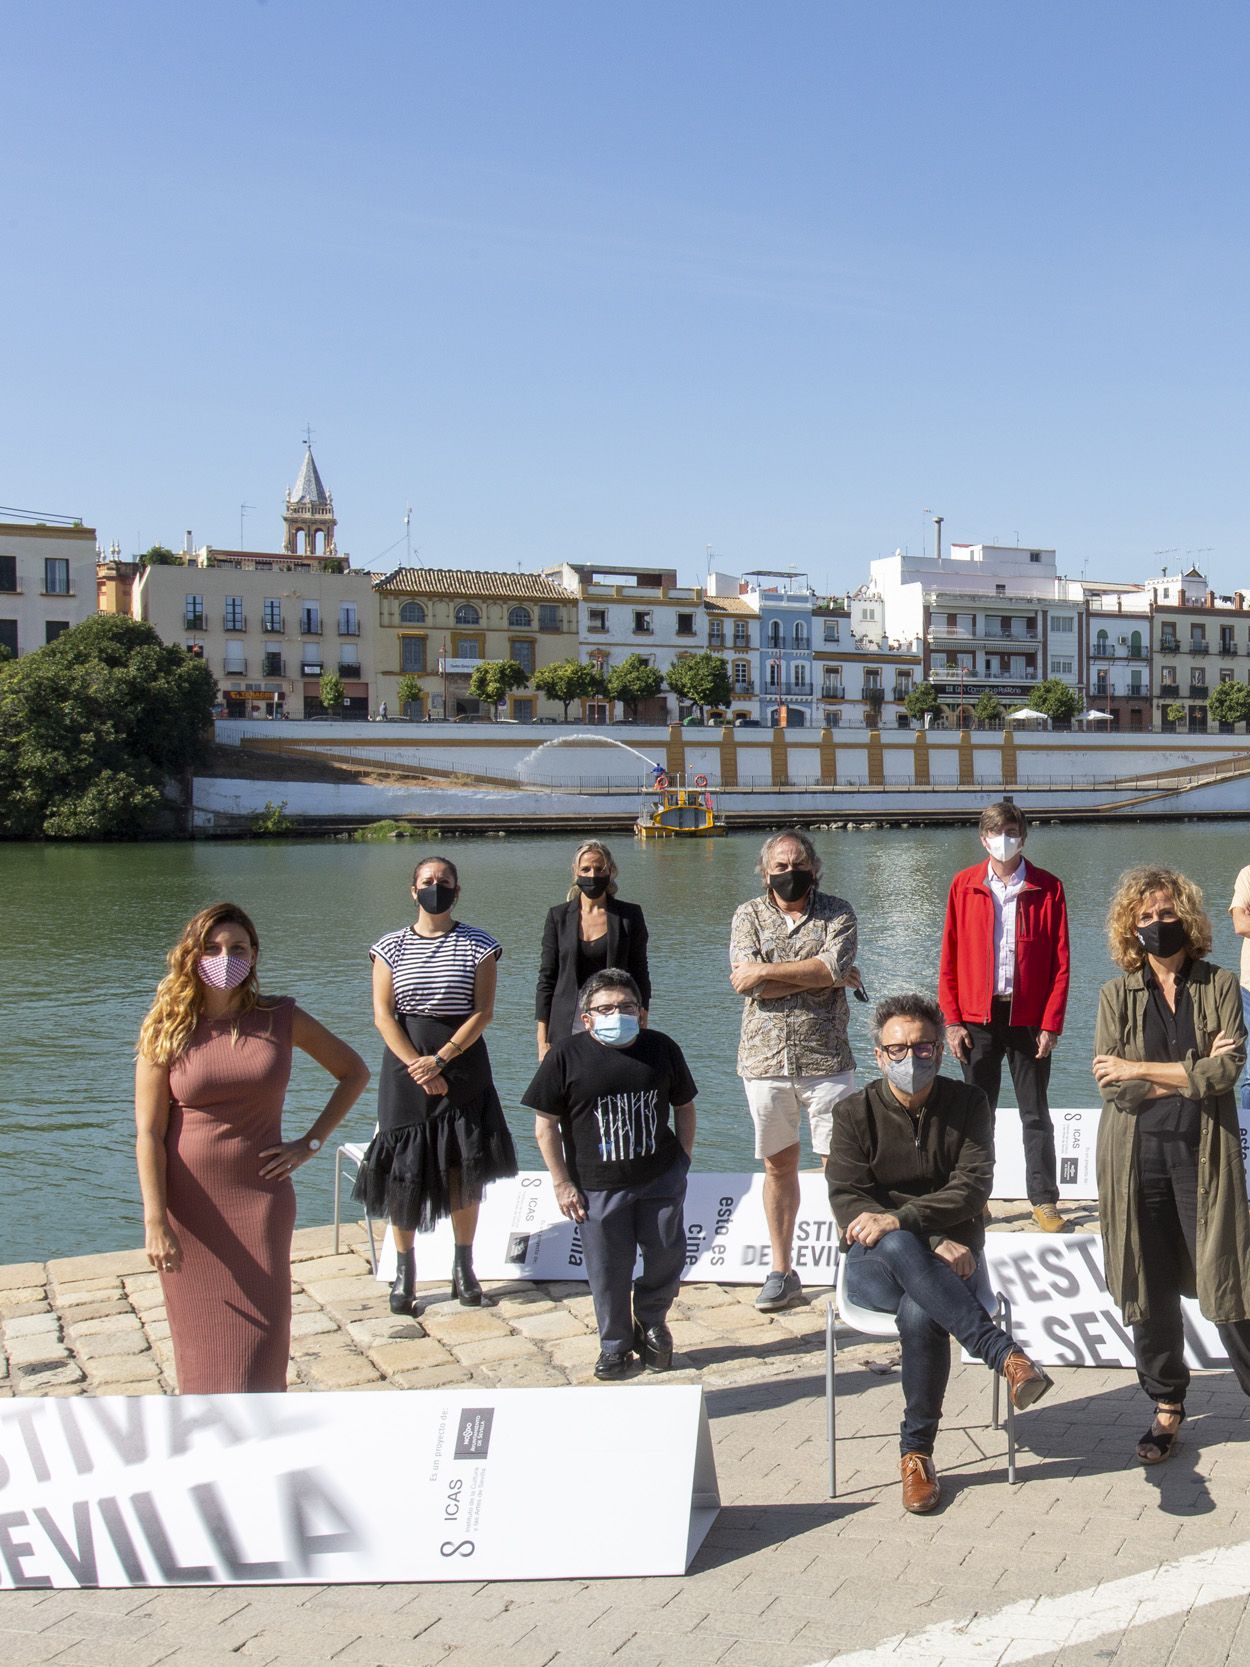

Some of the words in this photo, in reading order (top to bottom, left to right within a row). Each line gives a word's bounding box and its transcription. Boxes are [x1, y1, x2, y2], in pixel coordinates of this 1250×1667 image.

[525, 1197, 538, 1222] ICAS
[715, 1196, 734, 1236] esto
[685, 1224, 706, 1266] cine
[710, 1244, 726, 1266] es
[742, 1244, 771, 1266] DE
[434, 1422, 446, 1457] proyecto
[430, 1473, 438, 1482] Es
[432, 1460, 440, 1471] un
[444, 1479, 463, 1521] ICAS
[0, 1465, 375, 1588] EVILLA
